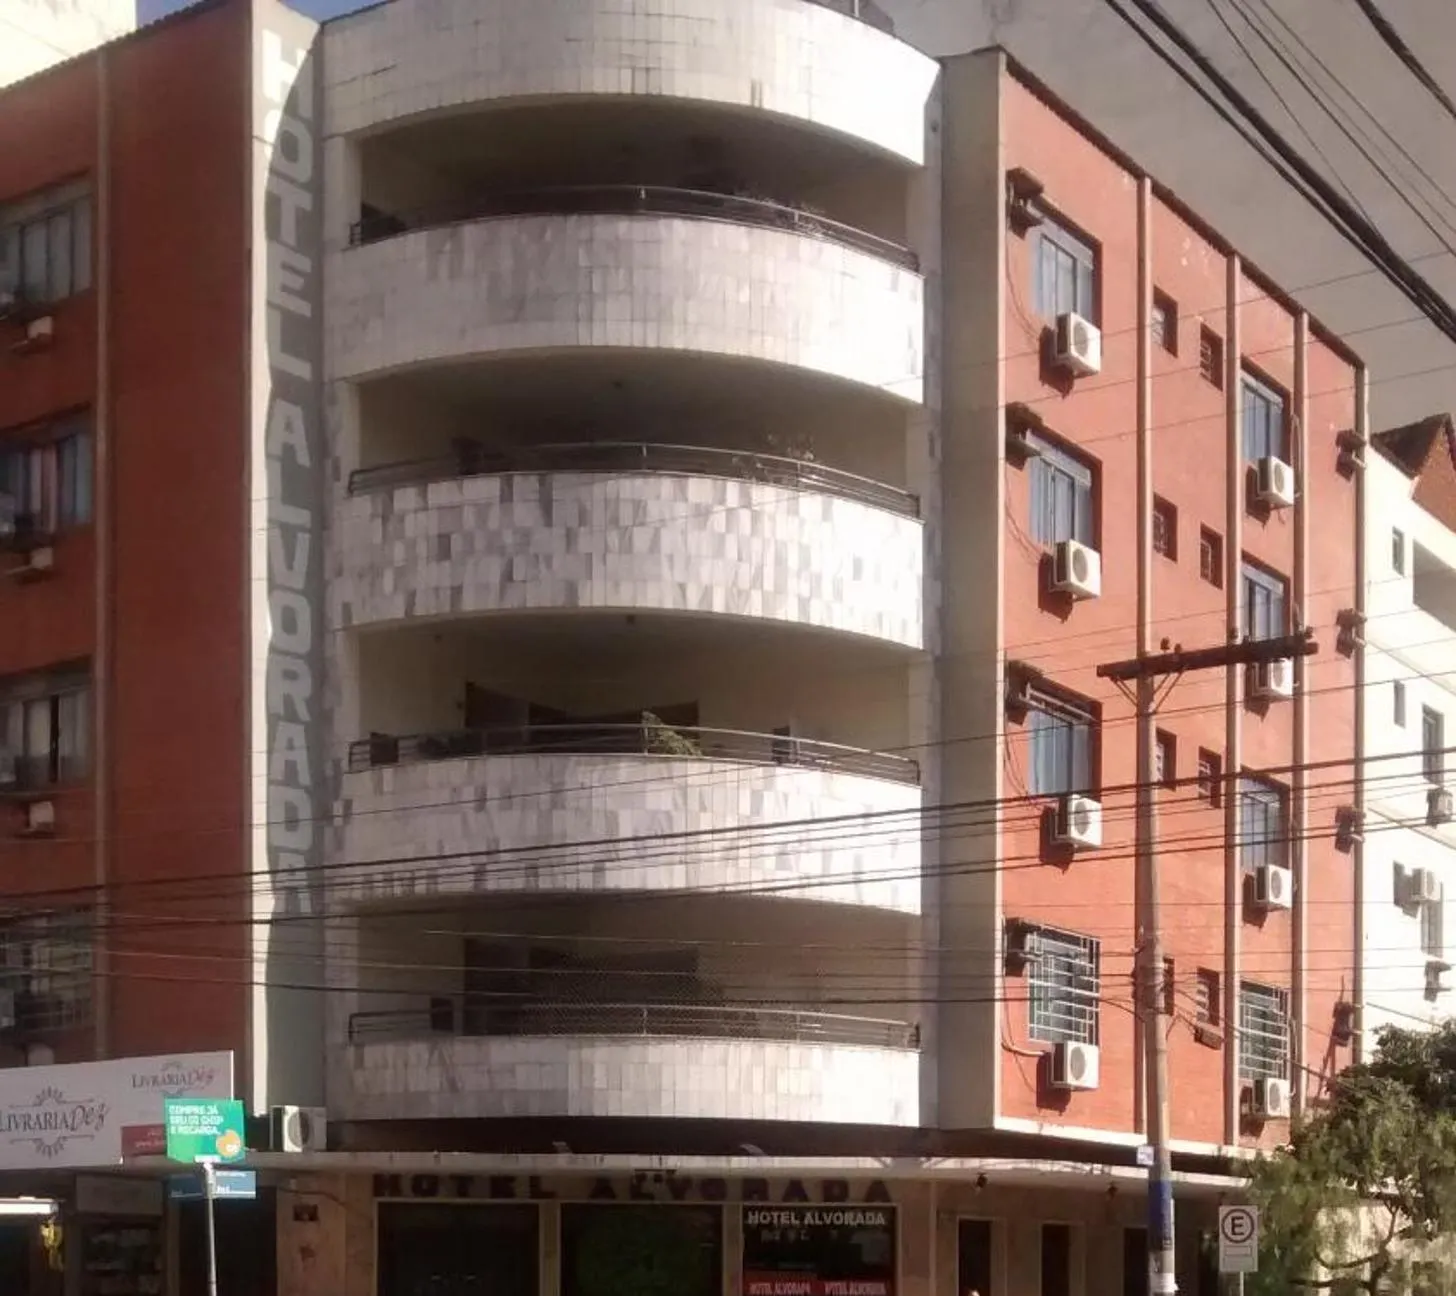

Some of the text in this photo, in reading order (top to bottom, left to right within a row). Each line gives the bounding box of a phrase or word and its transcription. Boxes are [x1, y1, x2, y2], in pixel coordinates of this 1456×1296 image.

[262, 28, 314, 914] HOTEL ALVORADA
[373, 1173, 893, 1203] HOTEL ALVORADA
[747, 1210, 885, 1225] HOTEL ALVORADA
[1231, 1215, 1245, 1236] E
